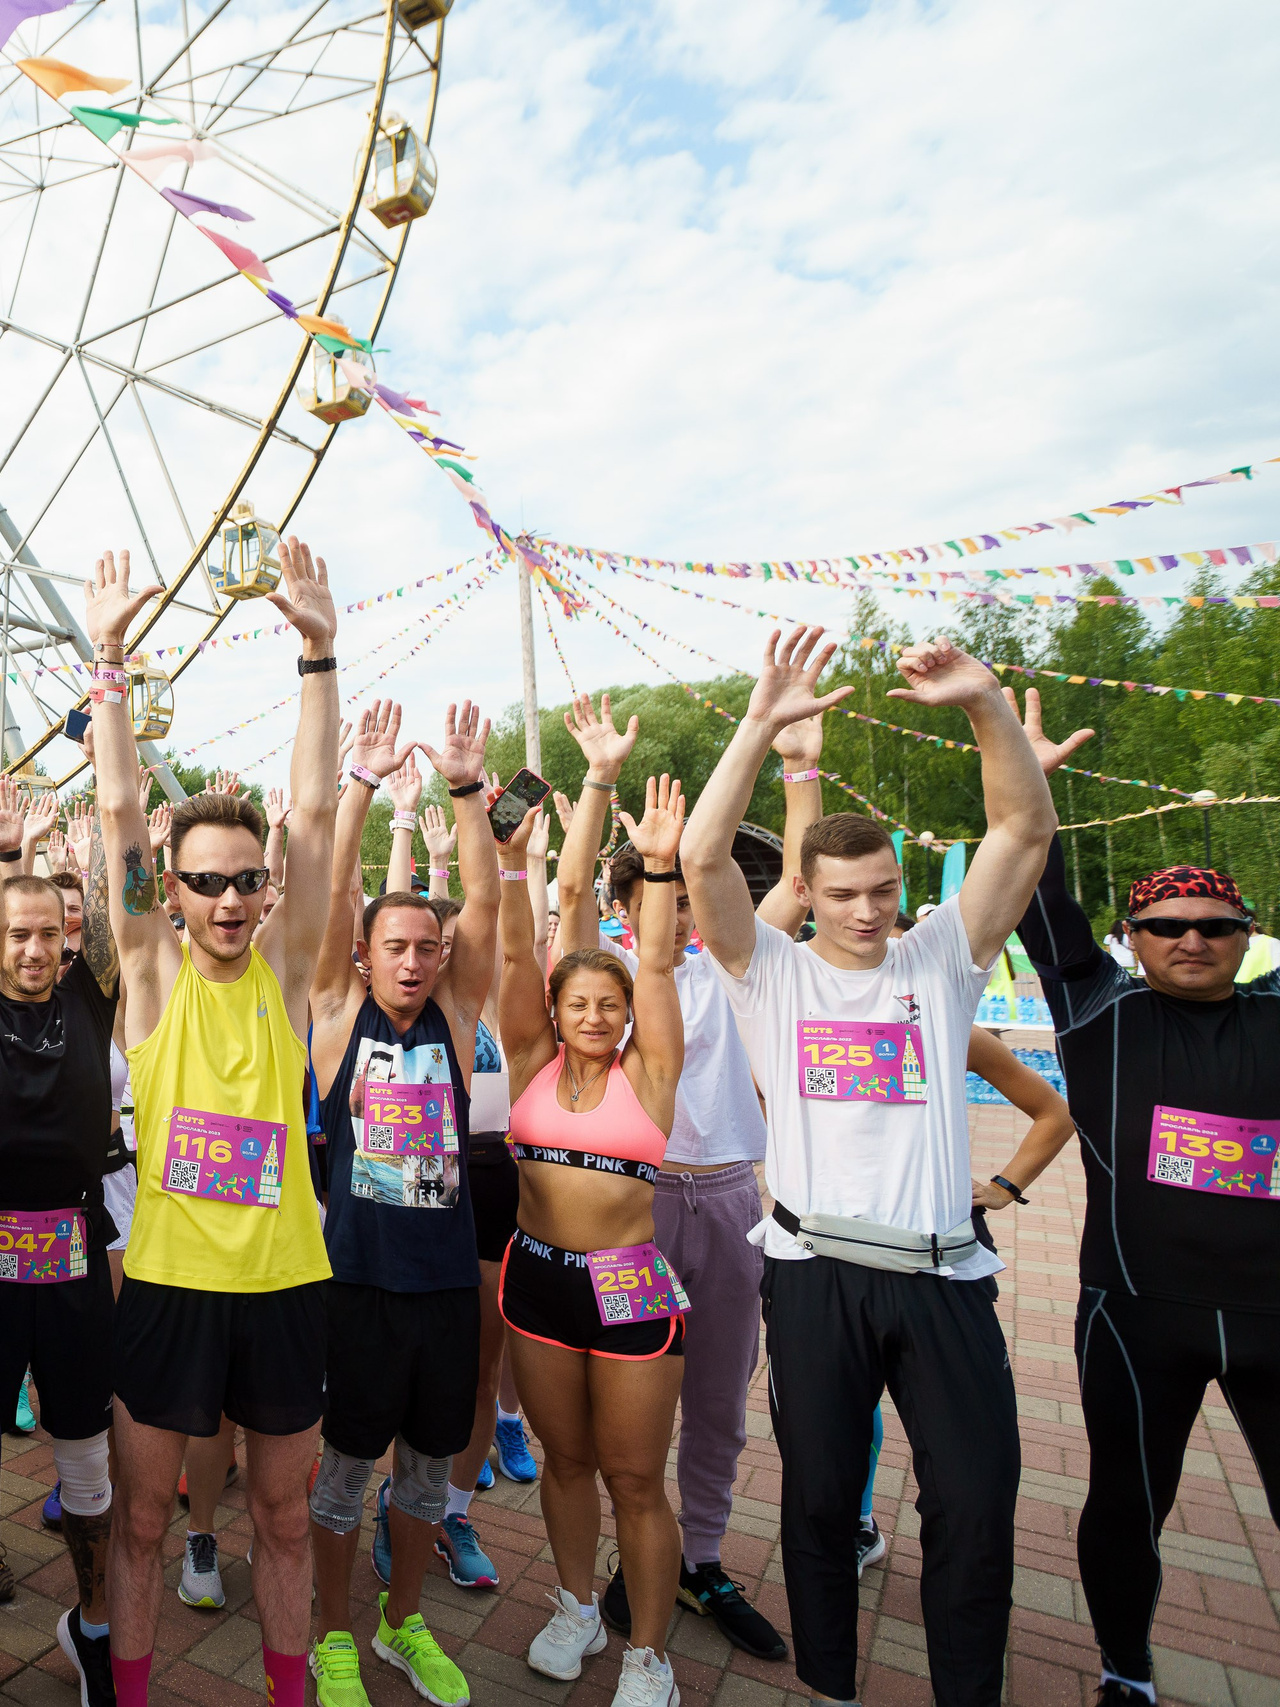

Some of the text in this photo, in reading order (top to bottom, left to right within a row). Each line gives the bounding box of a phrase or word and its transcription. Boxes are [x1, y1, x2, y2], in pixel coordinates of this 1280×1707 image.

[882, 1043, 889, 1052] 1
[803, 1043, 873, 1066] 125
[430, 1103, 435, 1111] 1
[177, 1114, 205, 1125] RUTS
[369, 1103, 422, 1125] 123
[1161, 1113, 1197, 1125] RUTS
[248, 1141, 254, 1151] 1
[1158, 1131, 1244, 1162] 139
[1261, 1137, 1268, 1147] 1
[174, 1133, 232, 1163] 116
[533, 1149, 571, 1164] PINK
[583, 1153, 626, 1173] PINK
[637, 1164, 658, 1182] PIN
[61, 1223, 67, 1232] 1
[521, 1234, 589, 1268] PINK PIN
[592, 1255, 617, 1263] RUTS
[657, 1260, 663, 1269] 2
[596, 1267, 653, 1293] 251
